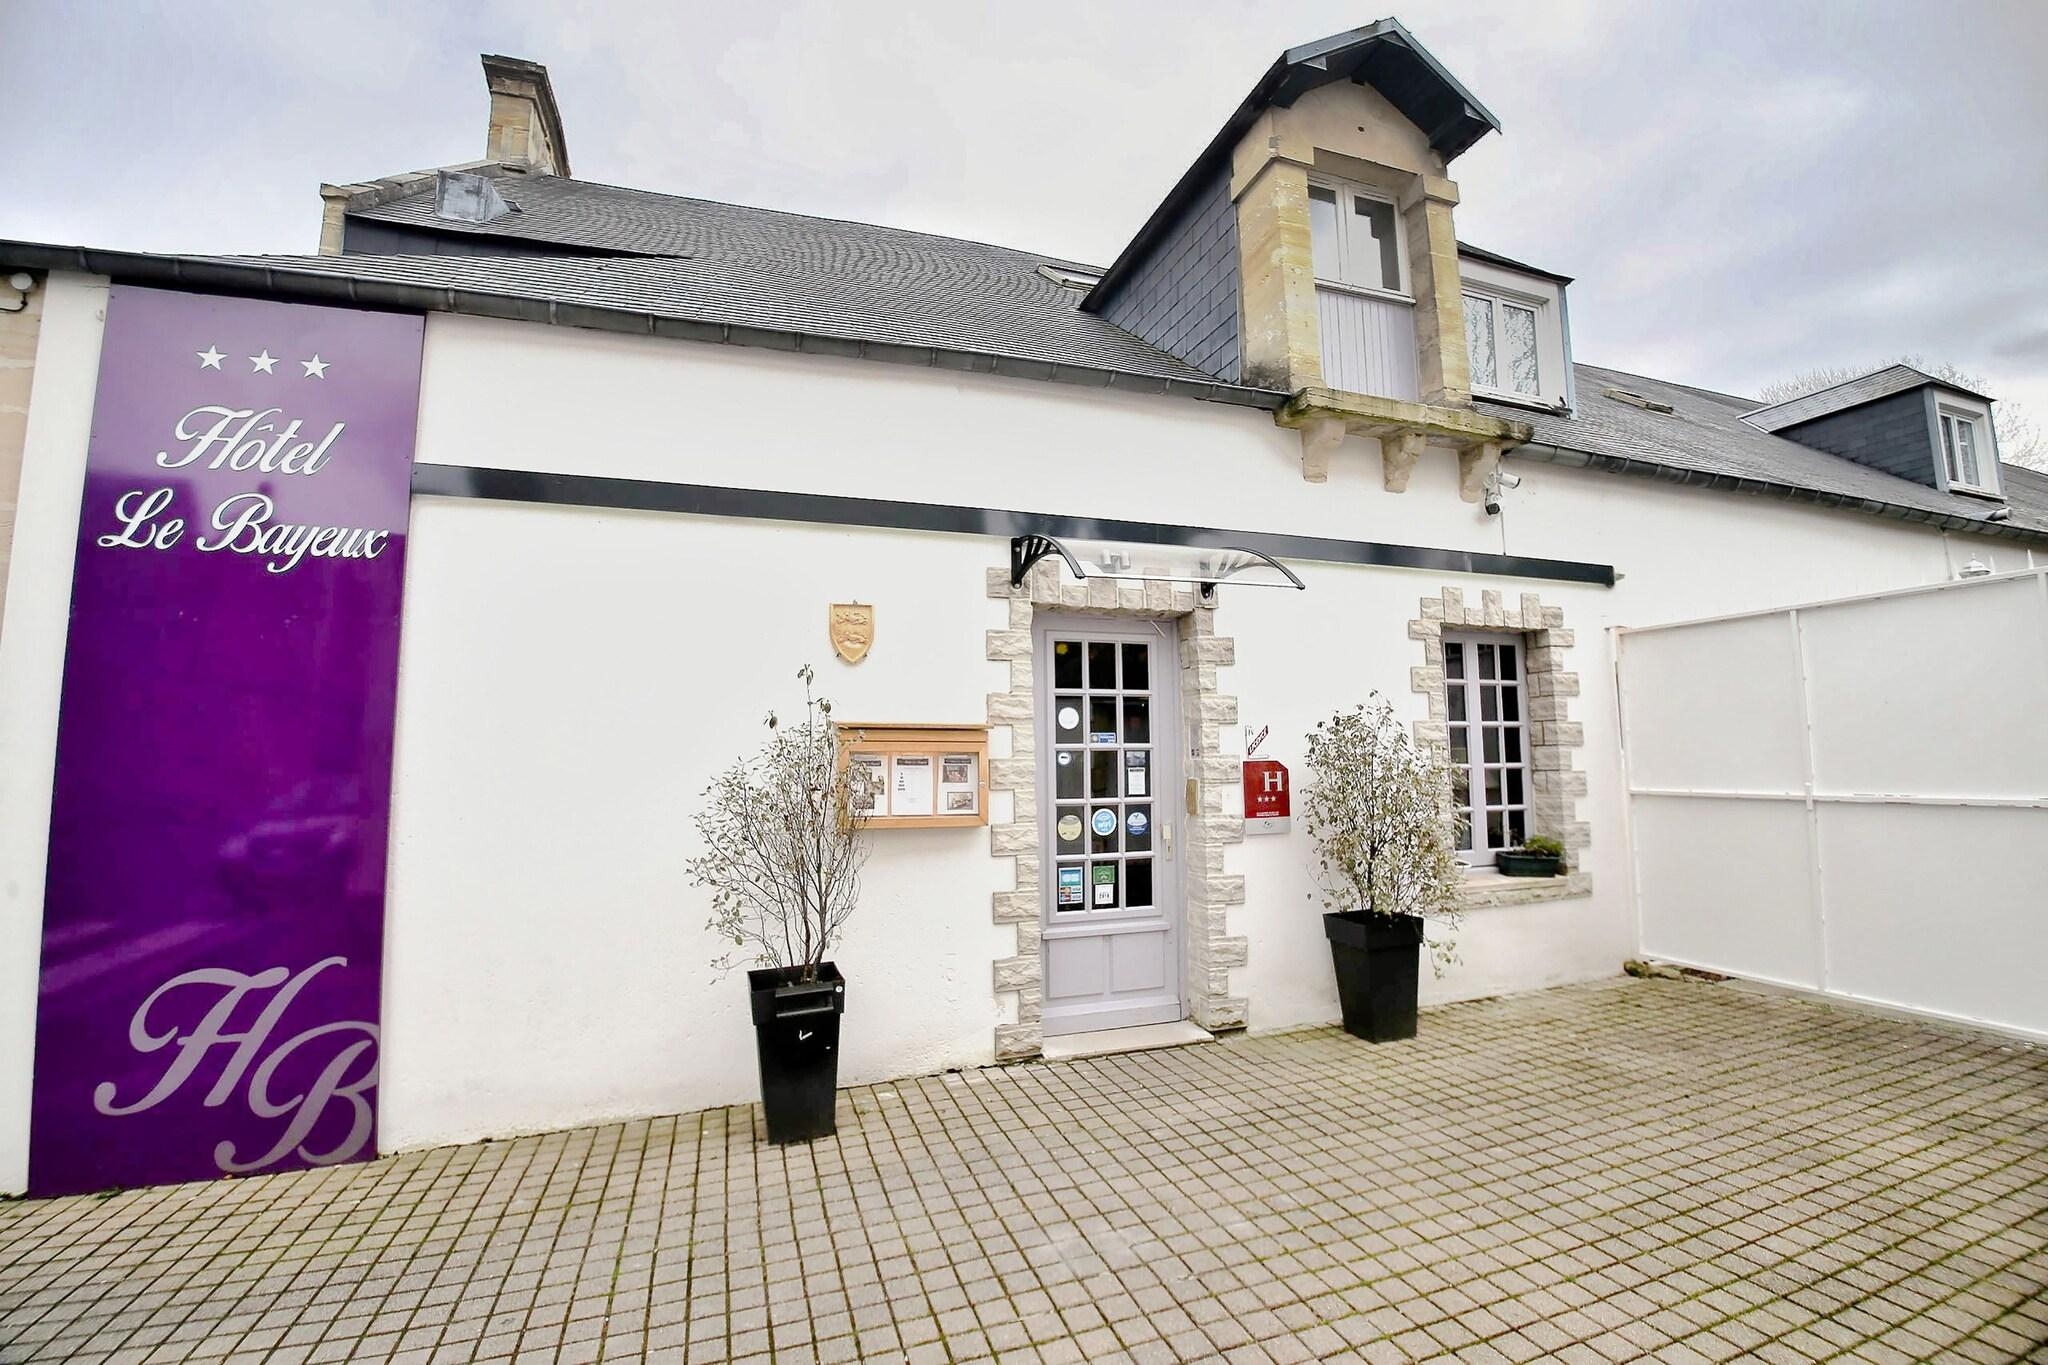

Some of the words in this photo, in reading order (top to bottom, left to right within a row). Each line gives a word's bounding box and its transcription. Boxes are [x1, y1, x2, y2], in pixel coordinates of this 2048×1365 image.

[156, 405, 346, 476] Hôtel
[97, 488, 184, 551] Le
[196, 493, 390, 574] Bayeux
[1263, 771, 1284, 792] H
